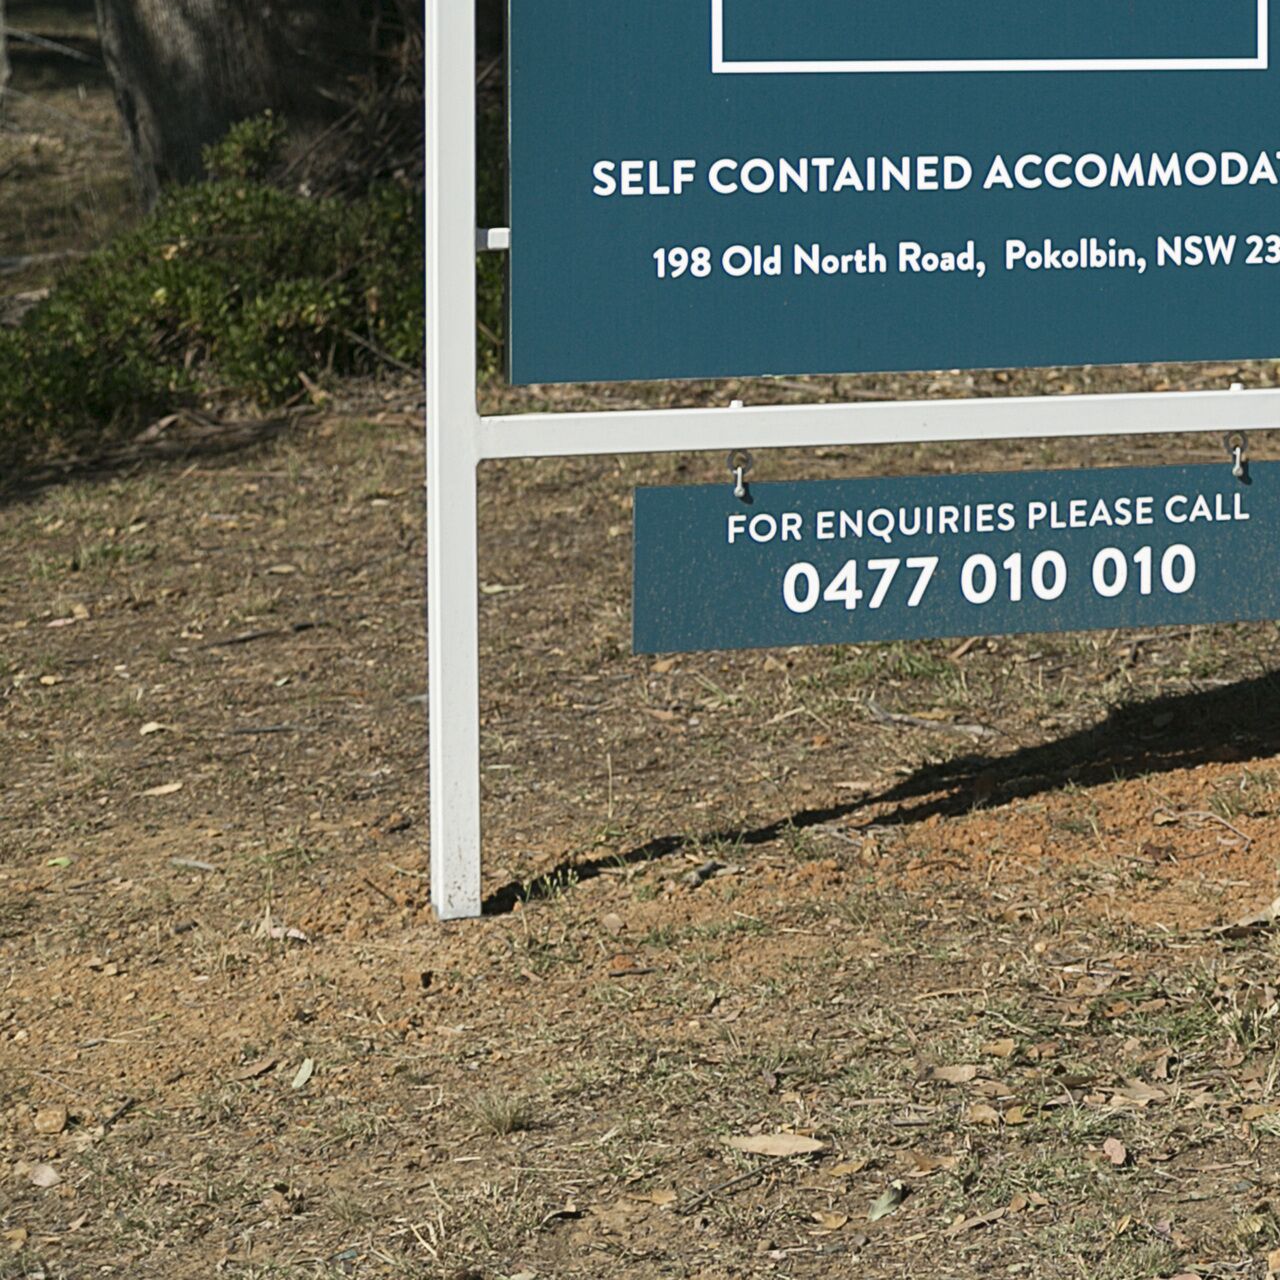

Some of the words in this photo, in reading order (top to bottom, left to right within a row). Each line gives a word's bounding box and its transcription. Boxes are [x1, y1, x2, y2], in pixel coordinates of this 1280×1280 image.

[592, 159, 696, 196] SELF
[708, 155, 973, 194] CONTAINED
[652, 246, 712, 278] 198
[721, 244, 782, 277] Old
[794, 242, 887, 275] North
[898, 240, 986, 278] Road,
[1005, 237, 1147, 274] Pokolbin,
[1157, 234, 1237, 267] NSW
[728, 512, 803, 544] FOR
[816, 502, 1016, 540] ENQUIRIES
[1028, 496, 1154, 530] PLEASE
[1164, 492, 1250, 523] CALL
[783, 556, 939, 613] 0477
[961, 550, 1067, 604] 010
[1092, 543, 1196, 597] 010
